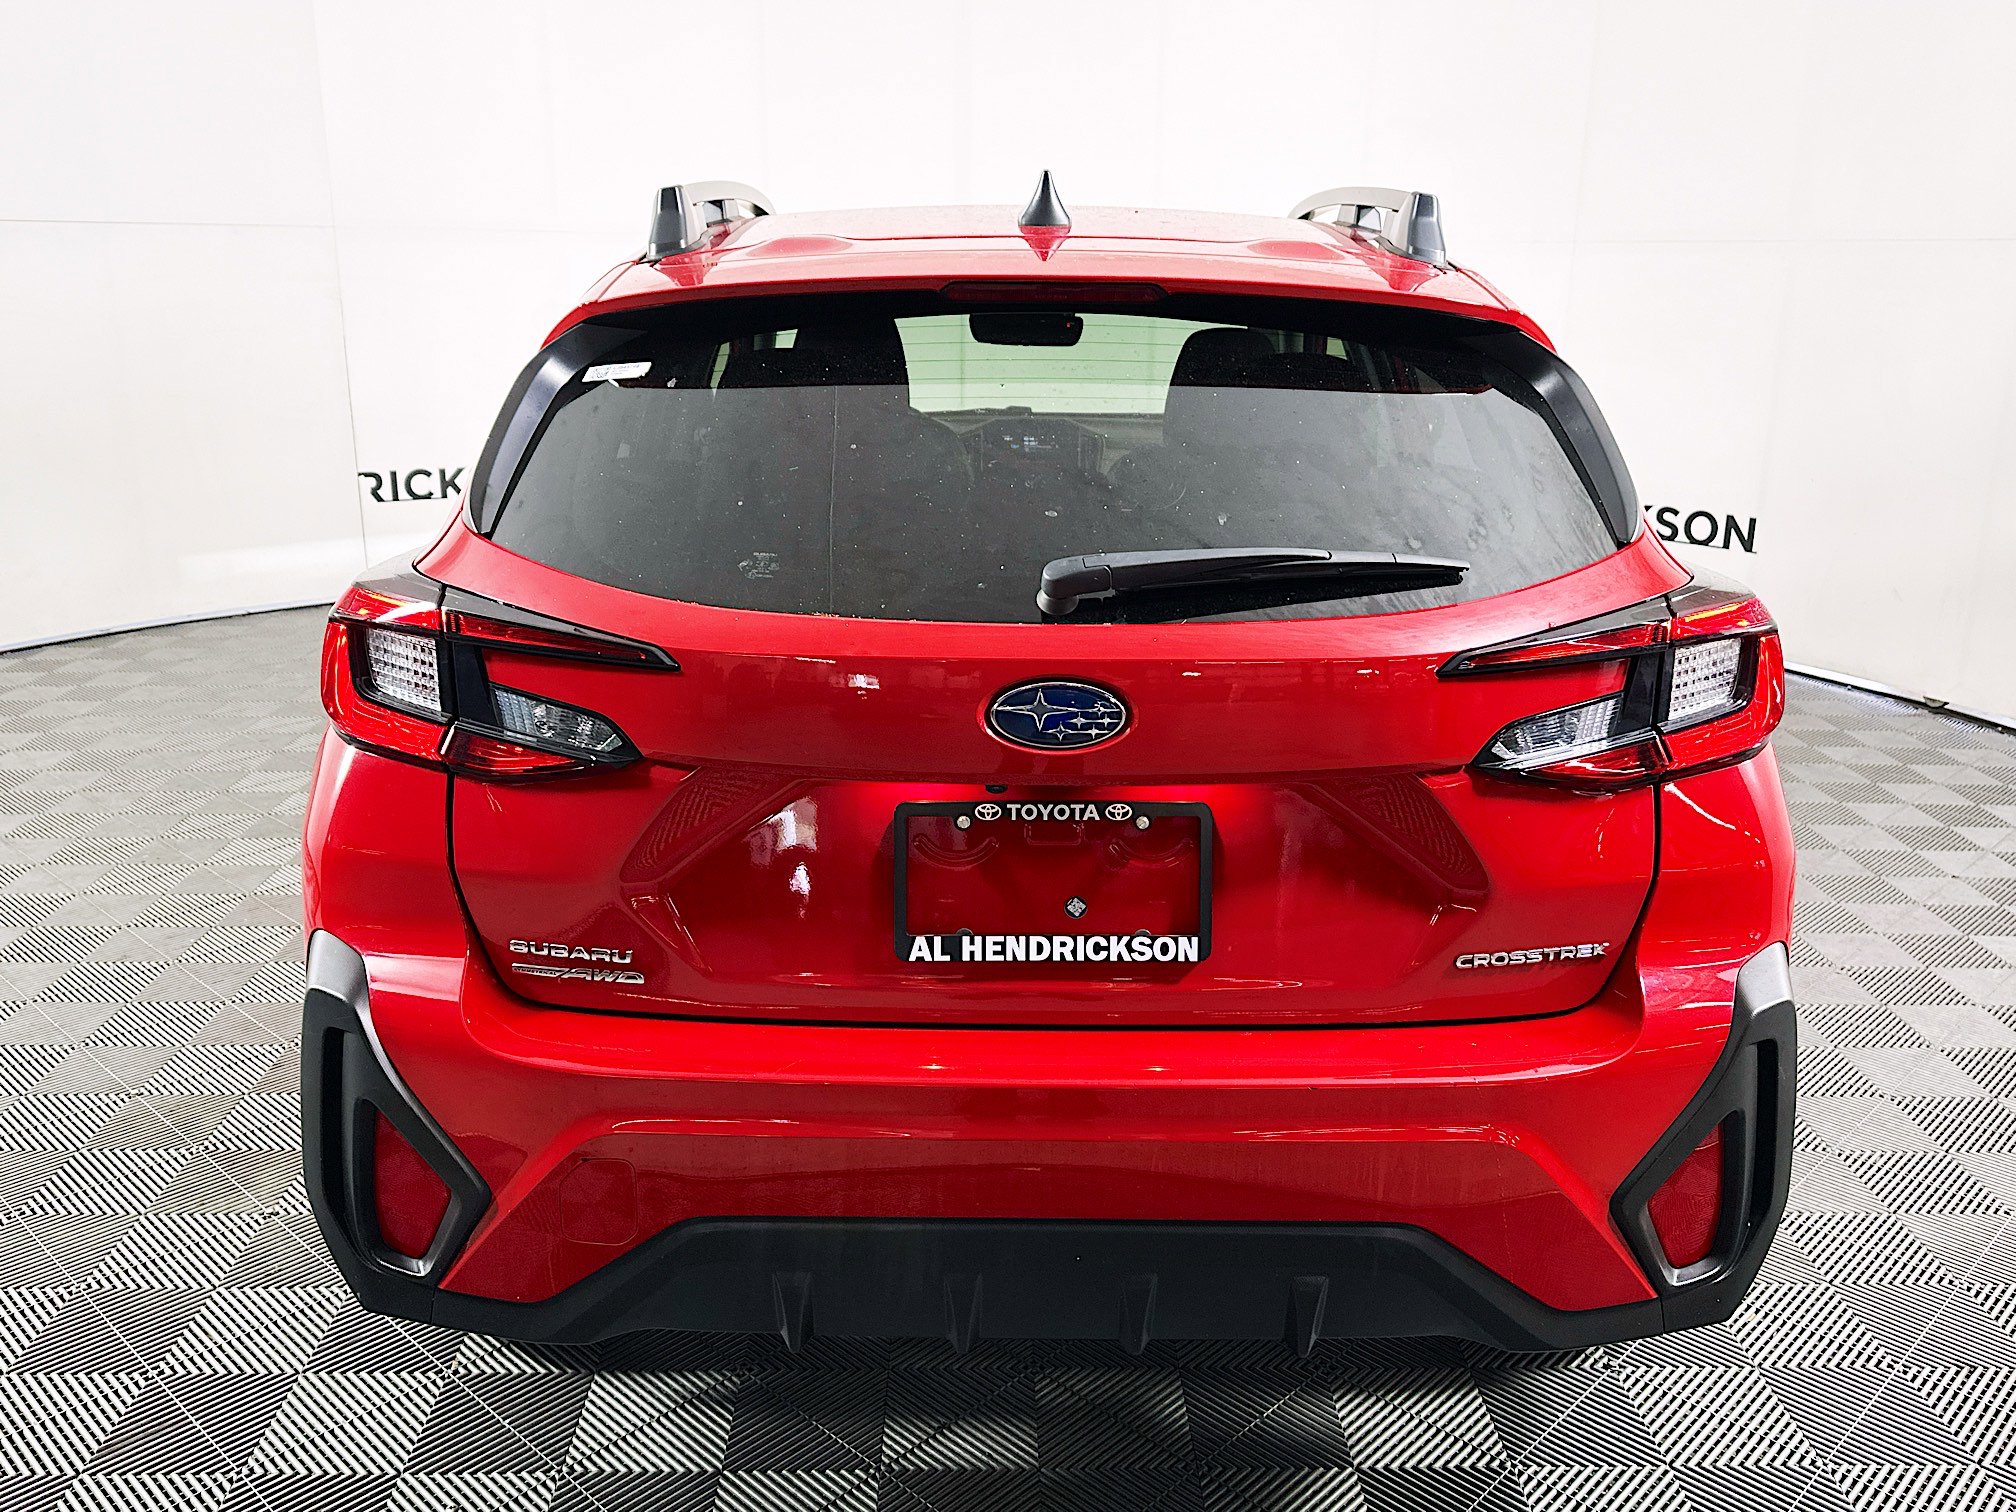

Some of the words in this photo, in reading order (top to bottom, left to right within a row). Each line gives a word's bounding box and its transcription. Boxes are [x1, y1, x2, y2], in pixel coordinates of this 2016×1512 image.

[1643, 505, 1757, 553] SON
[1006, 804, 1100, 821] TOYOTA
[509, 939, 633, 963] SUBARU
[908, 935, 950, 961] AL
[962, 935, 1199, 961] HENDRICKSON
[1455, 942, 1610, 969] CROSSTREK
[561, 967, 645, 984] AWD
